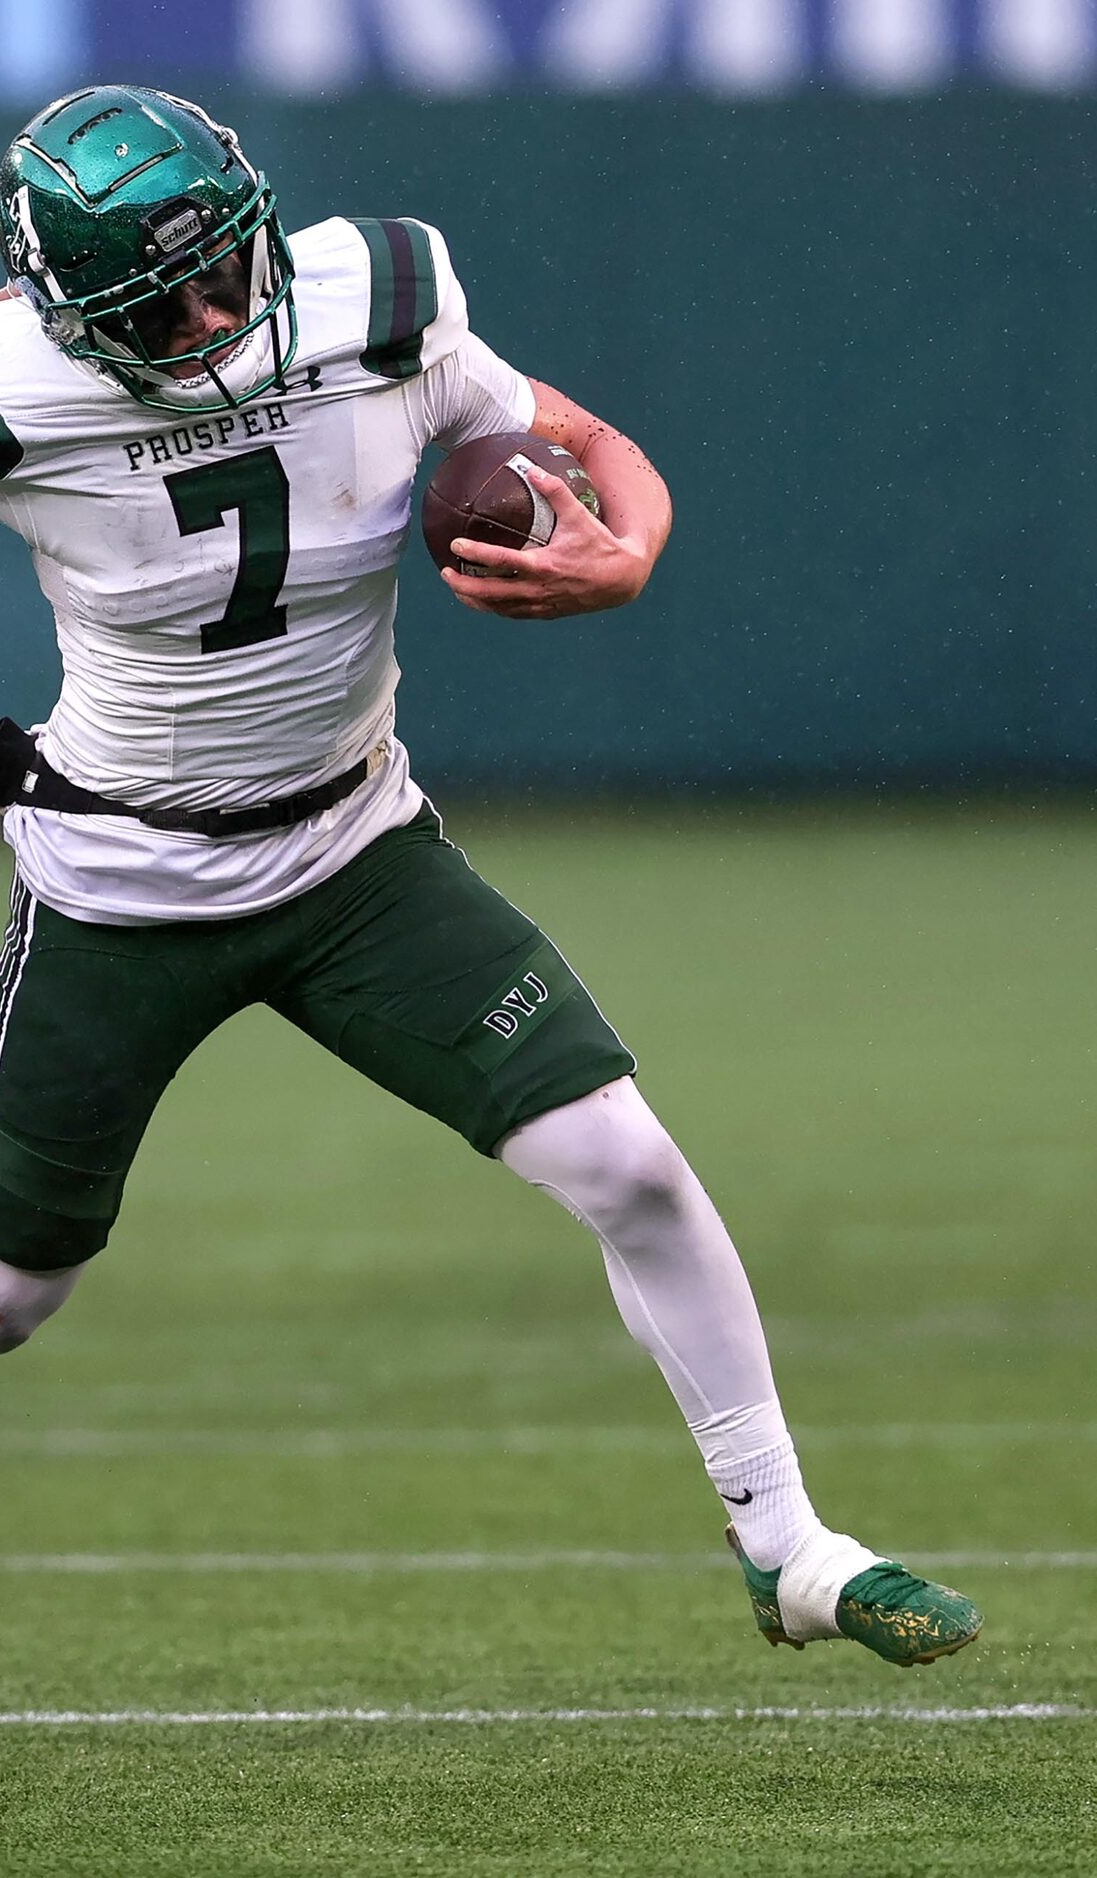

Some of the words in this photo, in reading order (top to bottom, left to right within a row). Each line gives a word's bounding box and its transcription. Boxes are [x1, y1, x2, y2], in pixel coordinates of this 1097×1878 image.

[122, 402, 290, 471] PROSPER
[162, 444, 291, 655] 7
[482, 971, 549, 1039] DYJ
